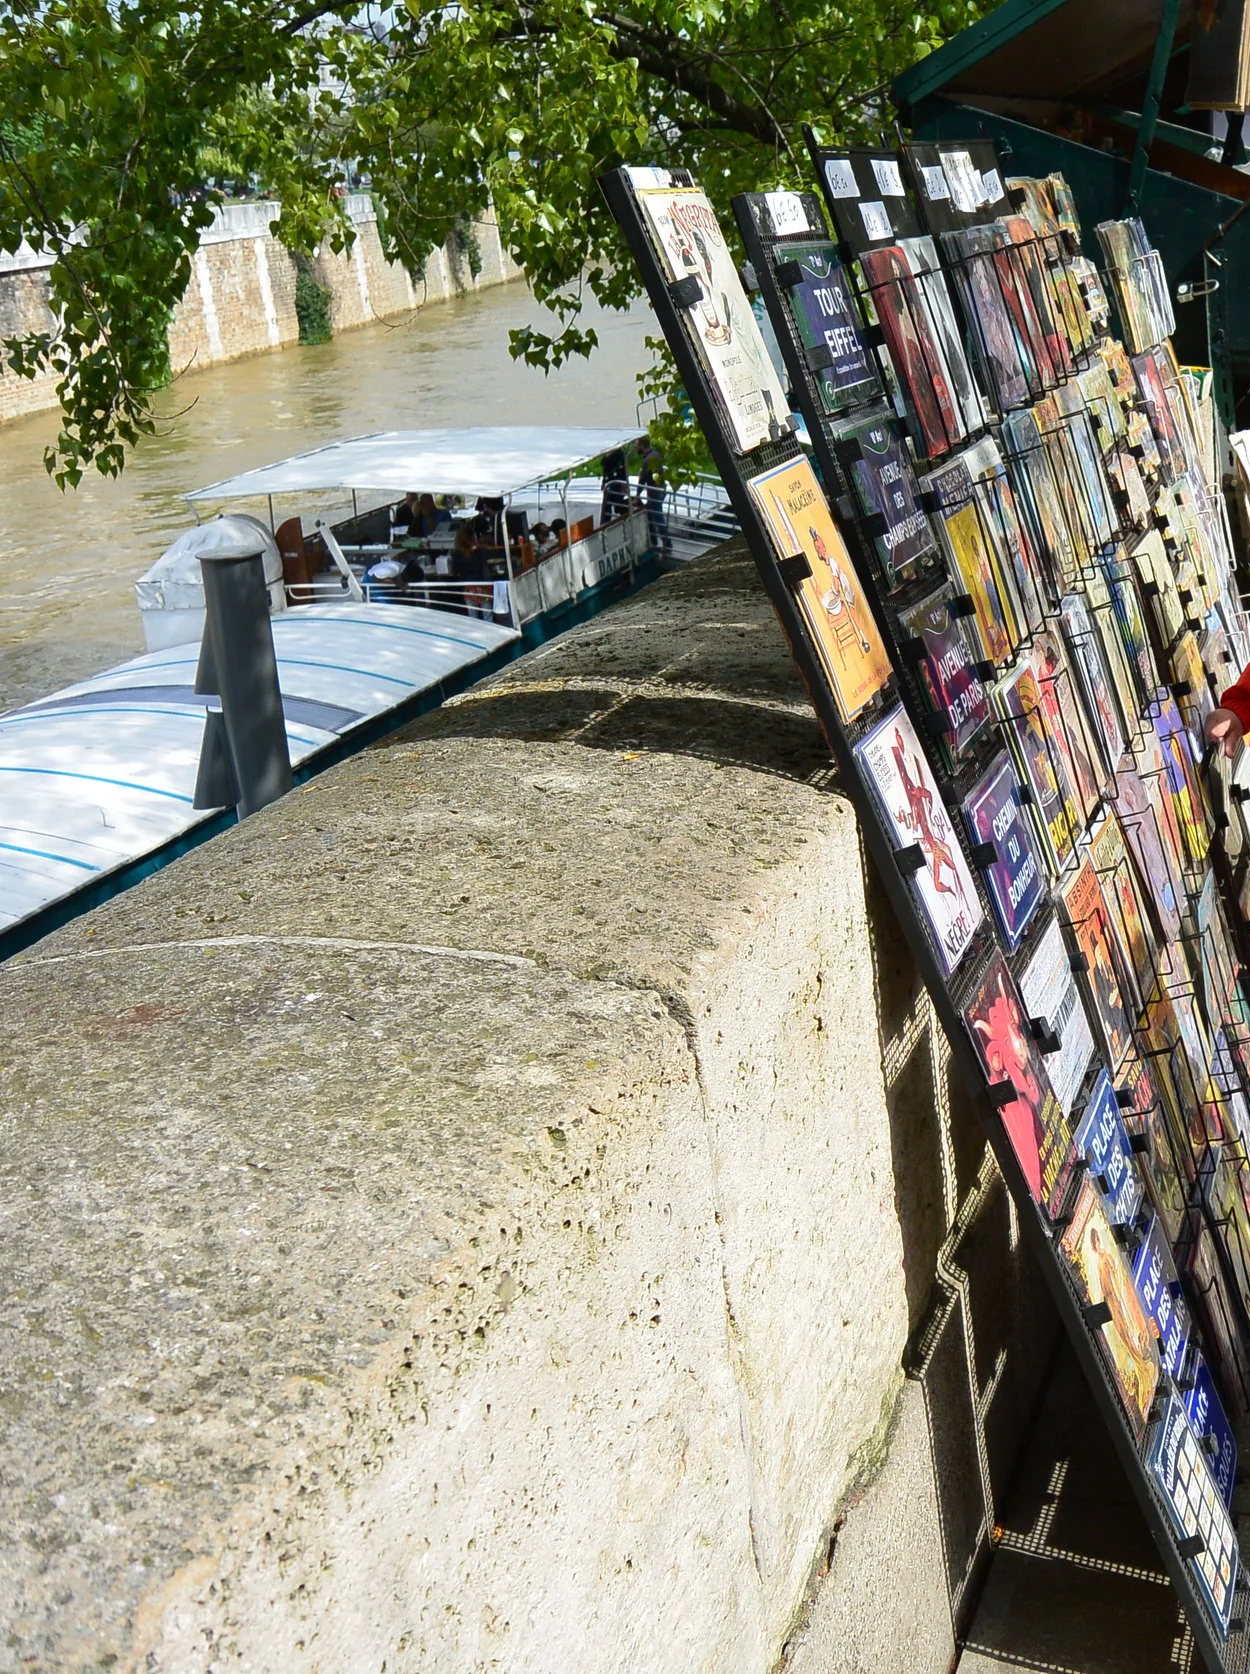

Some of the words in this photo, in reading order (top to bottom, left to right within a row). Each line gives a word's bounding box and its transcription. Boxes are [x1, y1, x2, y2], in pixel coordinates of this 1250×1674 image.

[813, 286, 848, 317] TOUR
[824, 326, 863, 358] EIFFEL
[878, 460, 902, 487] AVENUE
[893, 491, 906, 510] DES
[598, 544, 632, 578] DAPHN
[938, 640, 972, 686] AVENUE
[948, 697, 965, 729] DE
[961, 677, 983, 716] PARIS
[992, 794, 1018, 842] CHEMIN
[1008, 834, 1021, 864] DU
[1007, 851, 1037, 910] BONHEUR
[1091, 1103, 1117, 1164] PLACE
[1107, 1147, 1124, 1190] DES
[1143, 1245, 1165, 1311] PLACE
[1156, 1285, 1172, 1332] DES
[1161, 1293, 1187, 1376] ATALANS
[1217, 1432, 1233, 1499] SQUES
